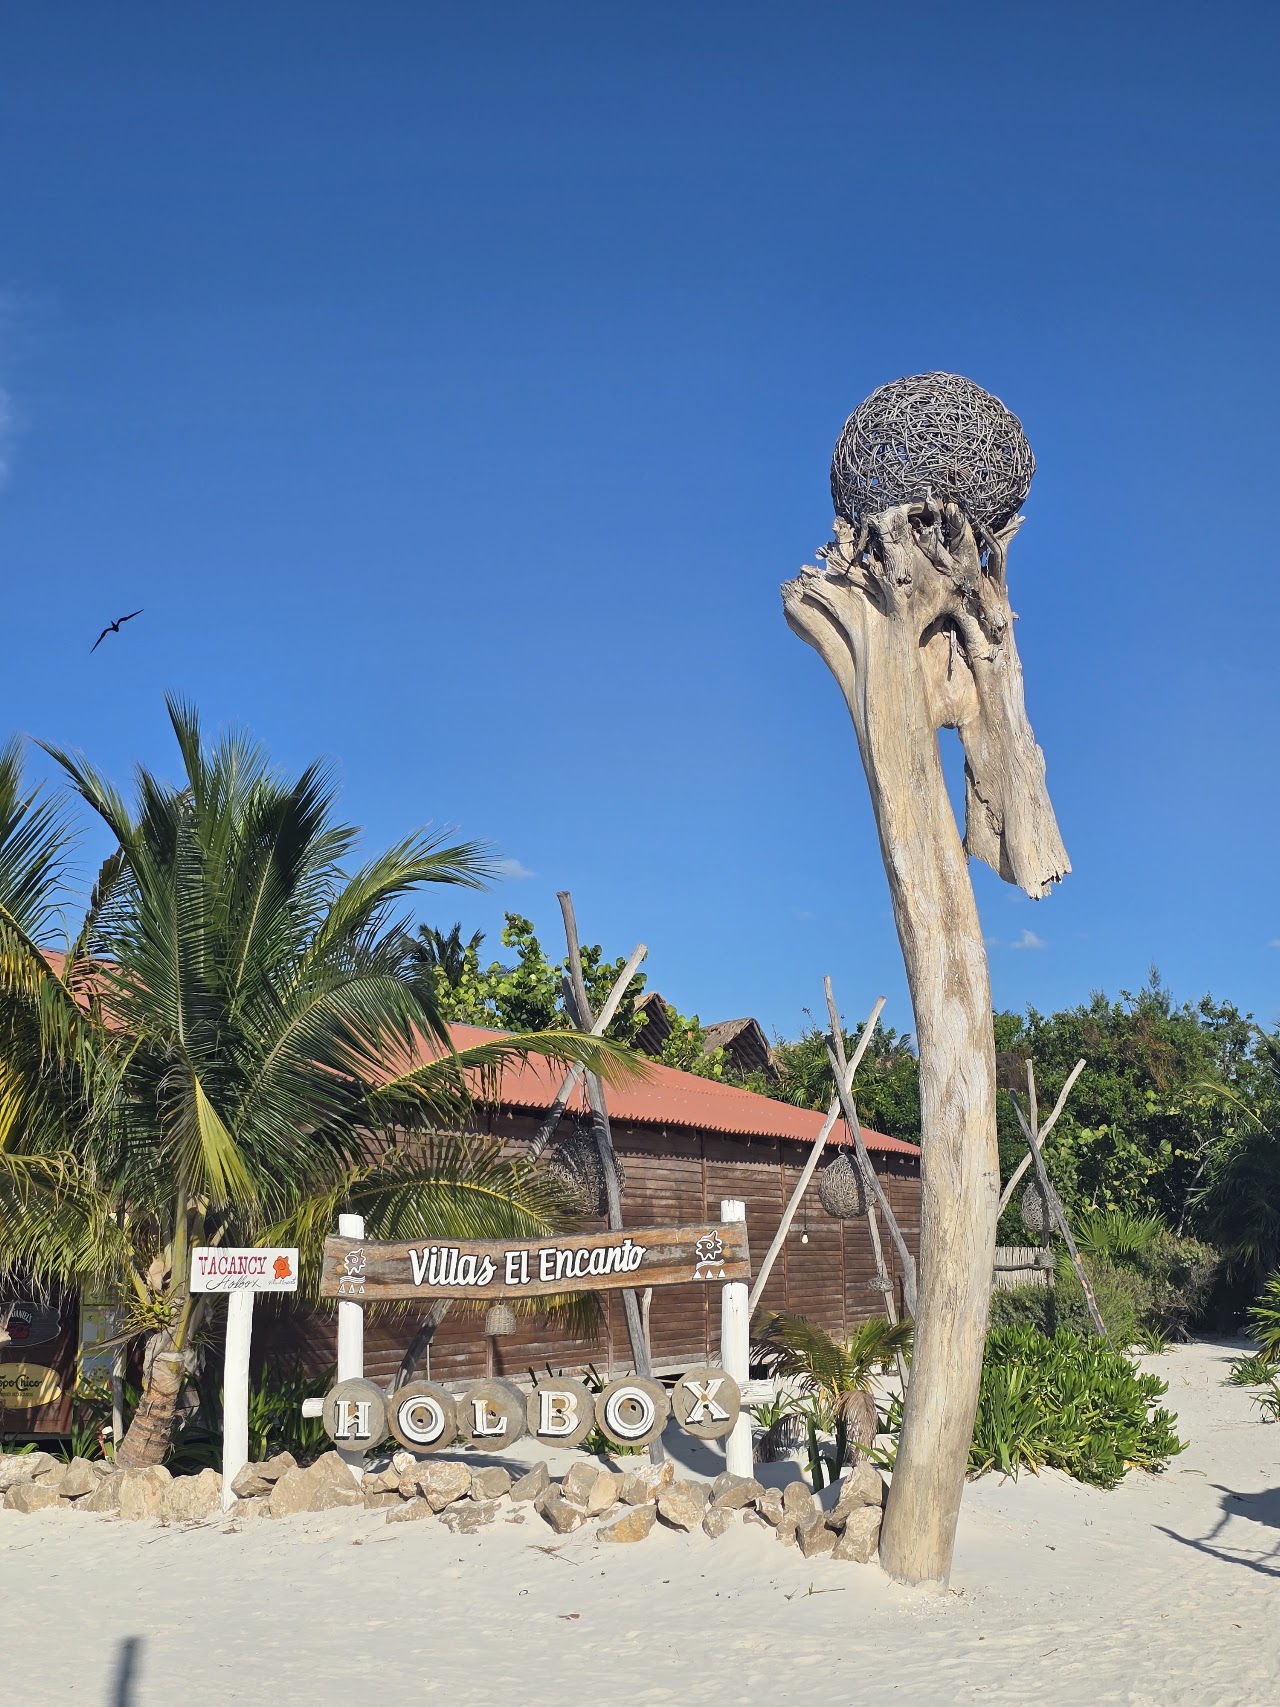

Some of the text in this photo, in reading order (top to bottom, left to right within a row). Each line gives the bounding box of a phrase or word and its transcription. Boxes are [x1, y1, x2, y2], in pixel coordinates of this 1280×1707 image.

[198, 1256, 268, 1275] VACANCY
[408, 1238, 647, 1286] Villas El Encanto
[205, 1275, 262, 1290] Holbox
[16, 1374, 43, 1391] Chico
[333, 1378, 731, 1443] HOLBOX
